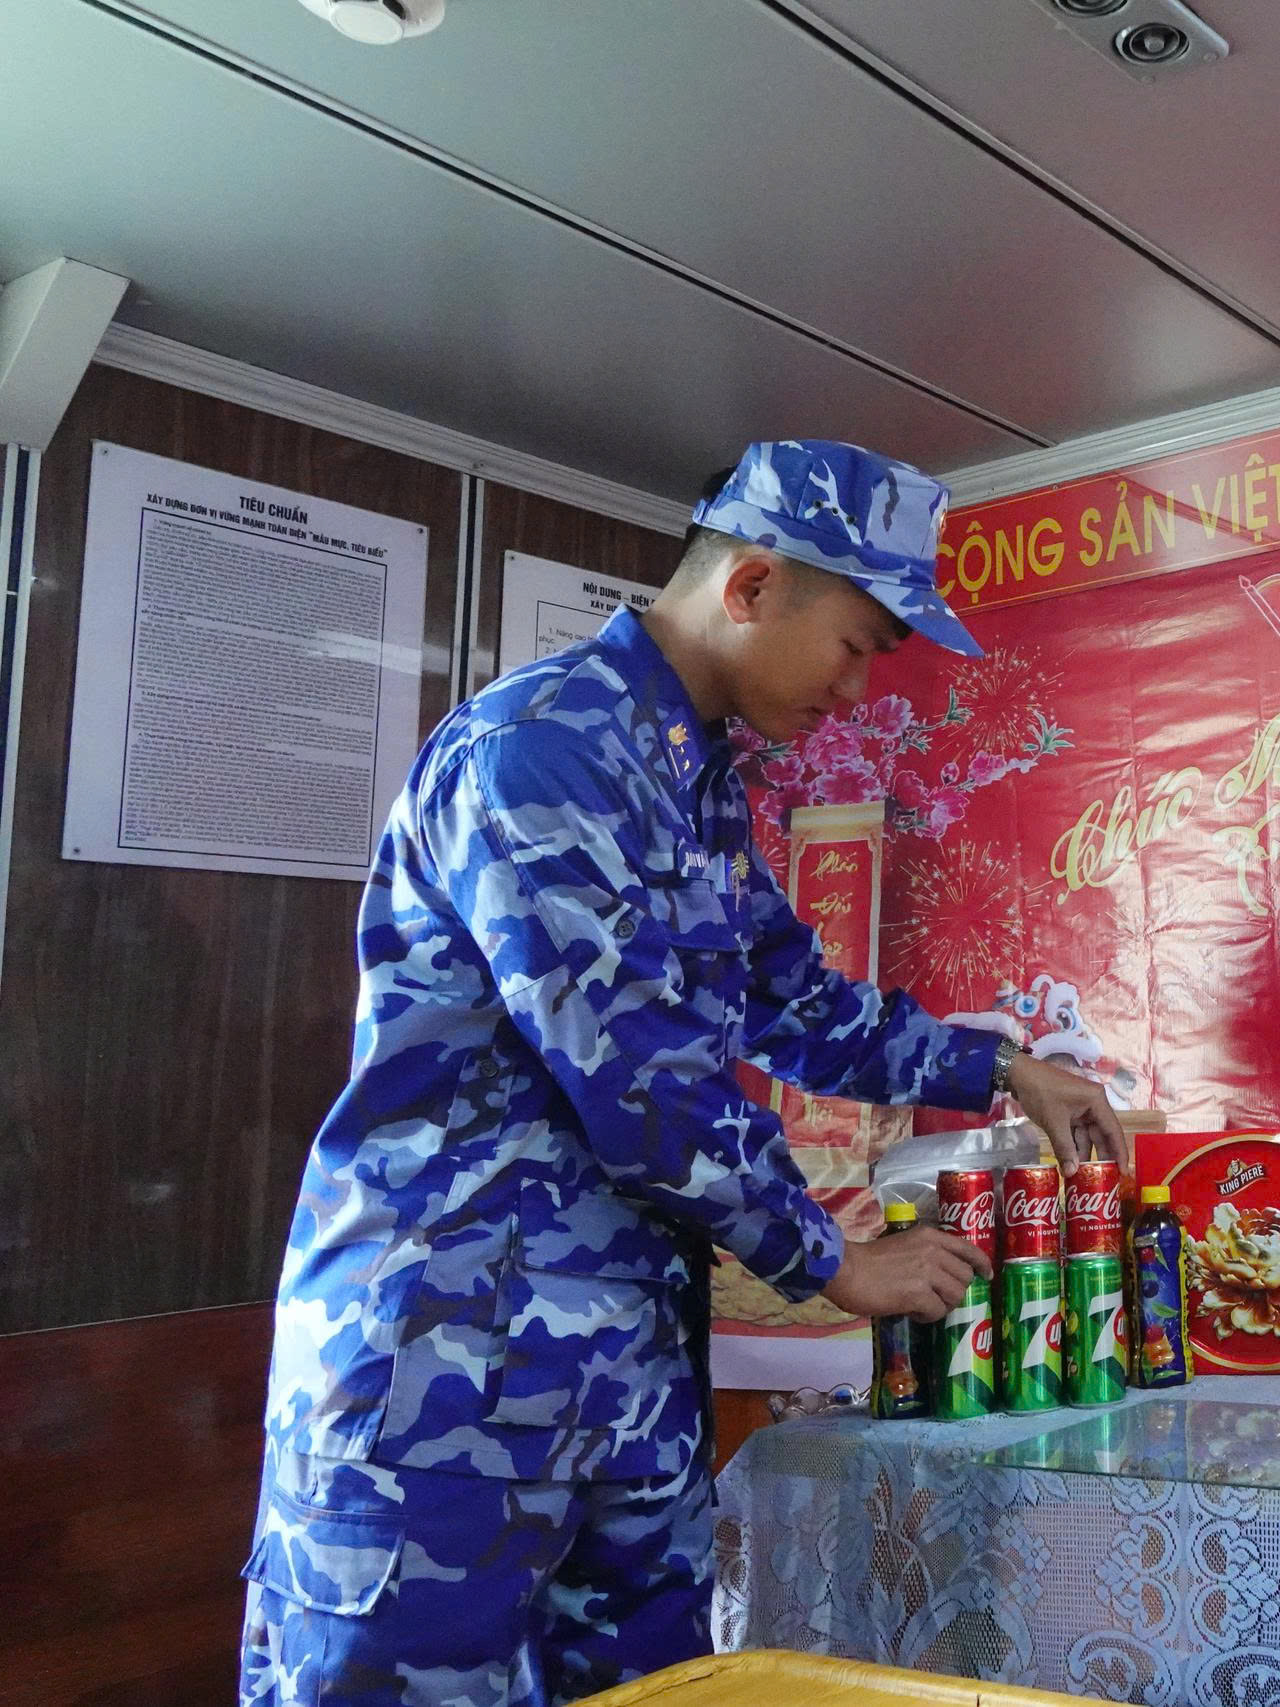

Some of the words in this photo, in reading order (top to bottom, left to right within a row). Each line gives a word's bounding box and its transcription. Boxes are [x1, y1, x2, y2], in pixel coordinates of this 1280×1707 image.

[239, 496, 265, 514] TIÊU
[268, 503, 308, 525] CHUẨN
[936, 517, 1065, 604] CỘNG
[1079, 481, 1176, 567] SẢN
[583, 582, 597, 596] NỘI
[600, 586, 622, 600] DUNG
[631, 593, 649, 607] BIỆN
[1050, 767, 1203, 905] Chúc
[1220, 1178, 1240, 1195] KING
